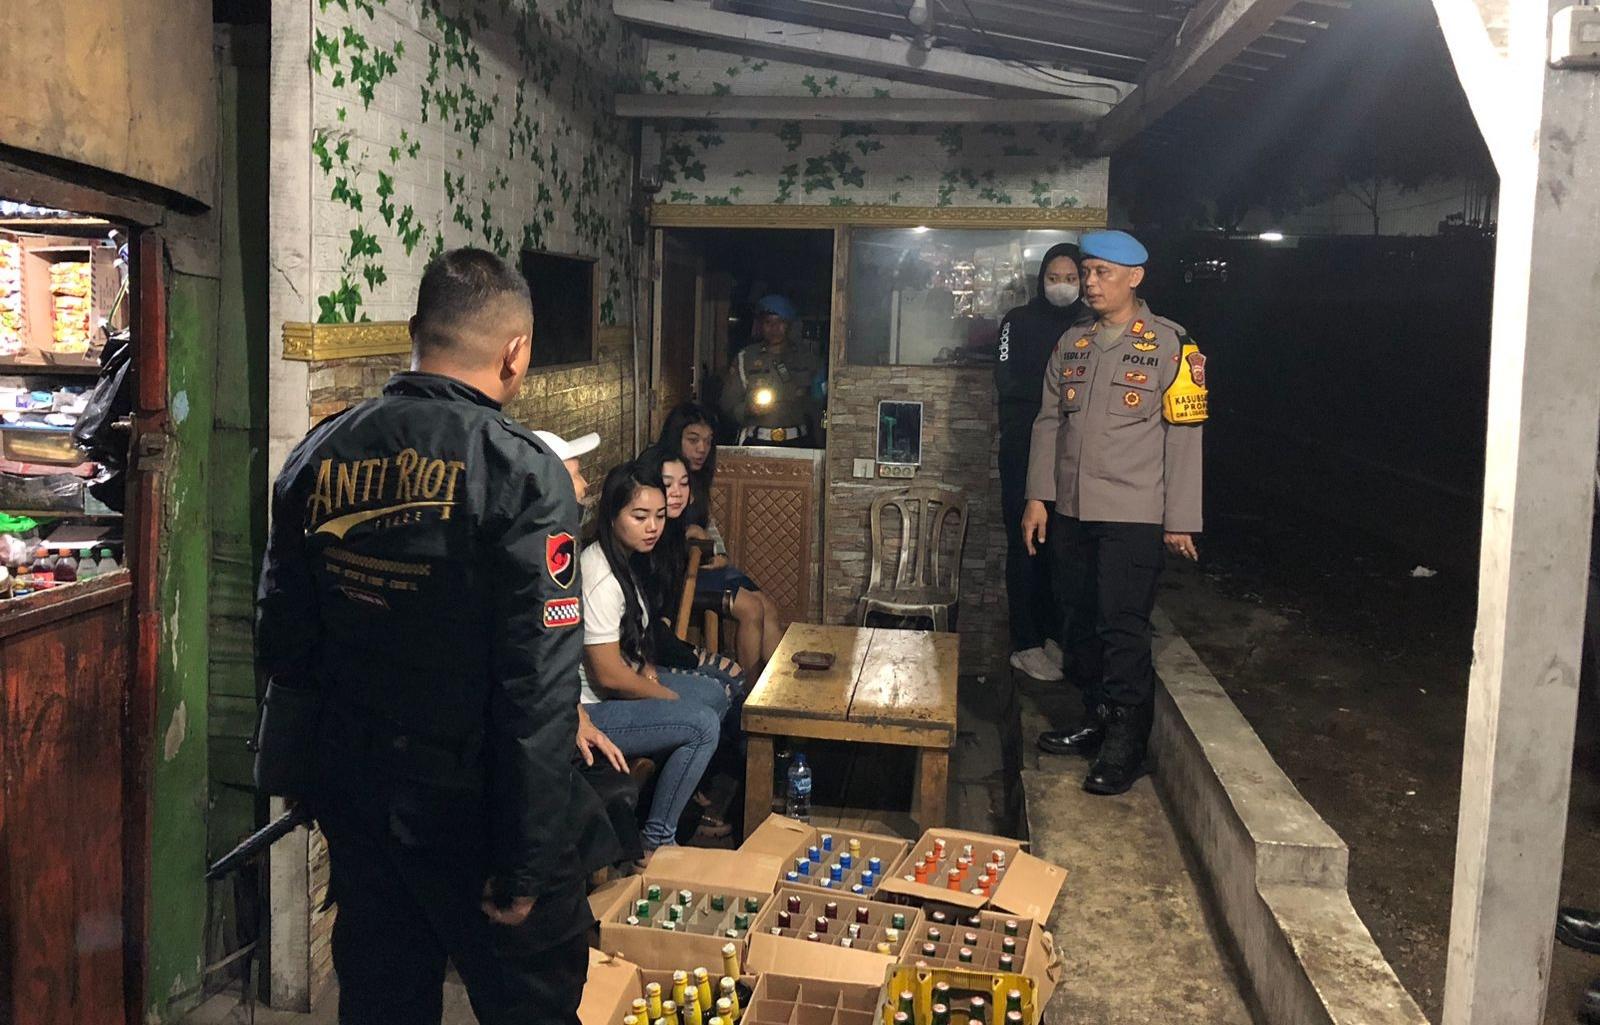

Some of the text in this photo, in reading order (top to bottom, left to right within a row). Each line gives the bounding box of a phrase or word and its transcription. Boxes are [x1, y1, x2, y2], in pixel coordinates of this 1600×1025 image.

[999, 321, 1010, 361] adidas
[1122, 354, 1159, 367] POLRI
[305, 447, 465, 526] ANTI RIOT
